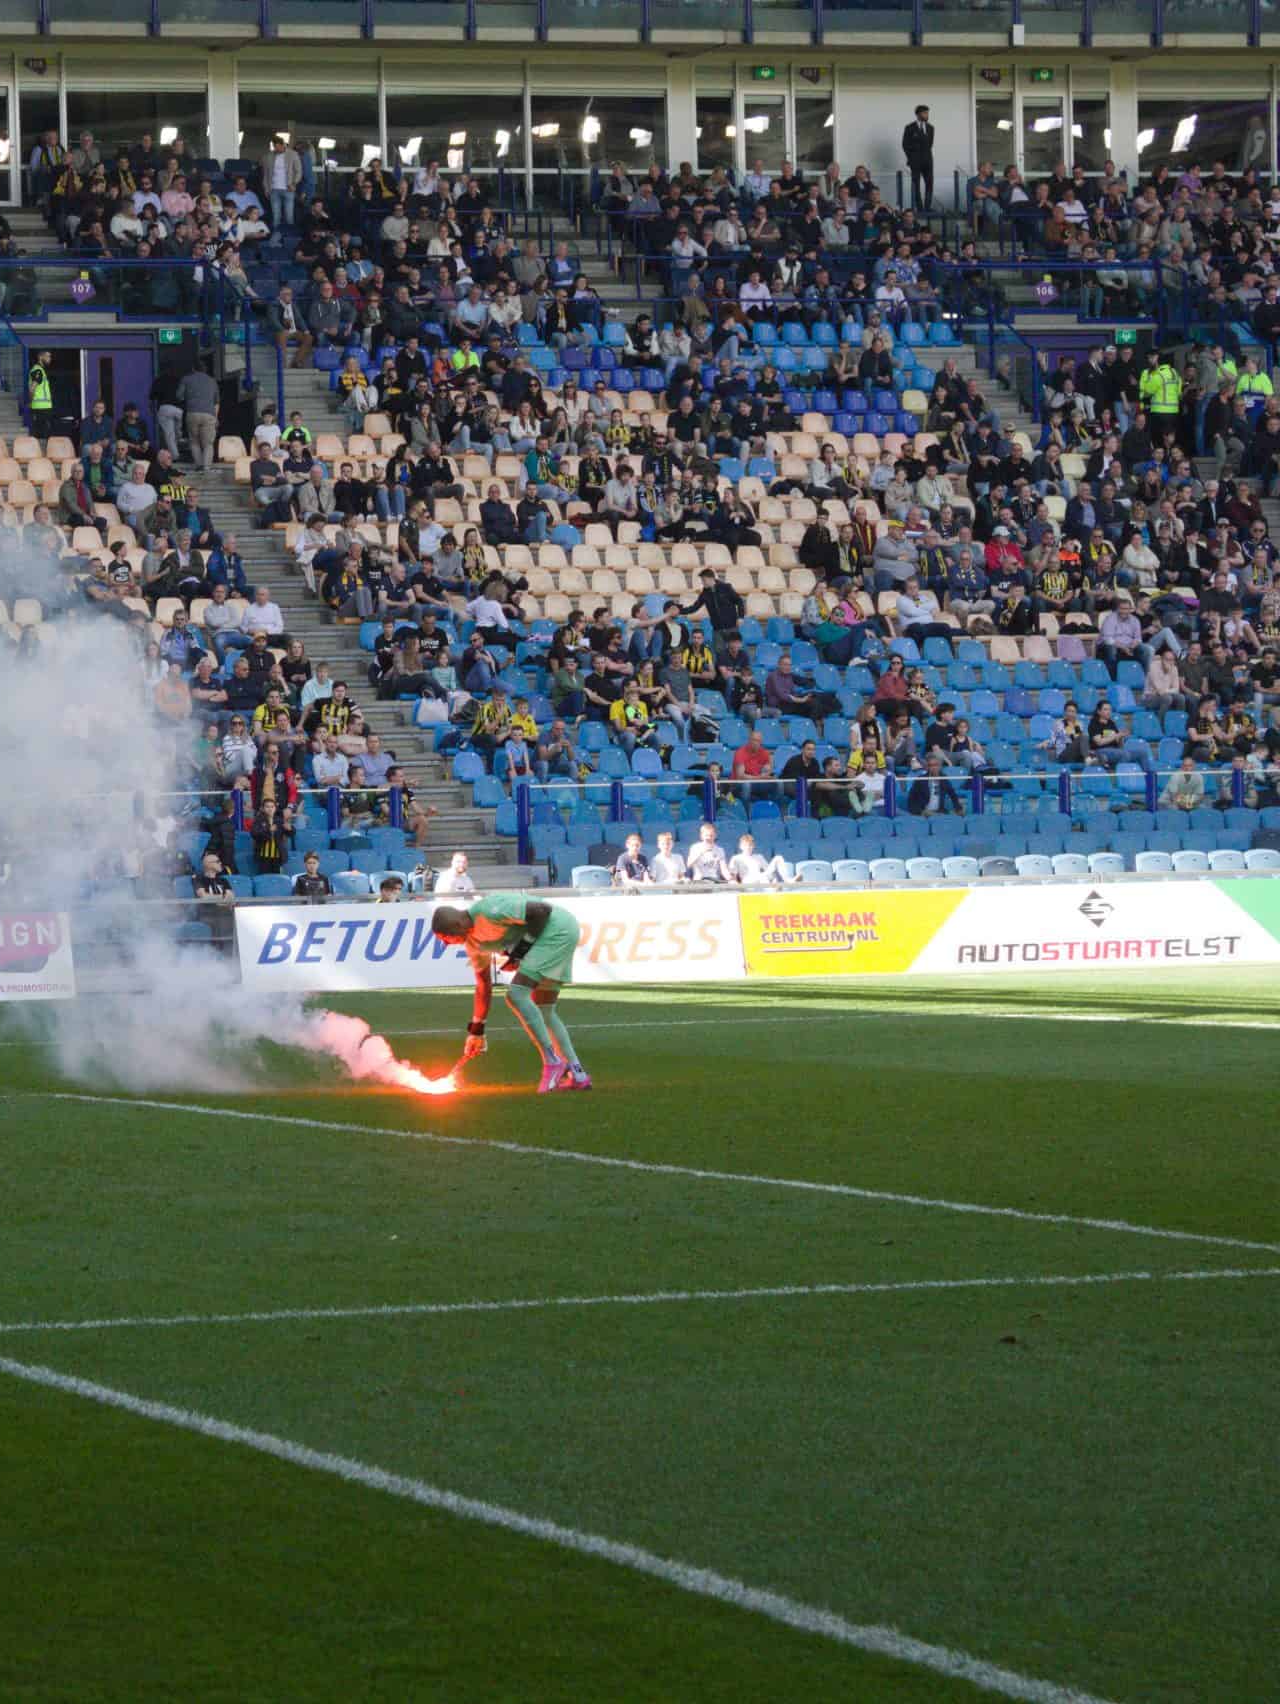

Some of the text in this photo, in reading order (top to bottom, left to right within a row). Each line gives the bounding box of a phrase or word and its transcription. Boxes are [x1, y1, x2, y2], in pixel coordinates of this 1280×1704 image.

[72, 283, 90, 293] 107
[760, 912, 877, 929] TREKHAAK
[257, 918, 468, 964] BETUW
